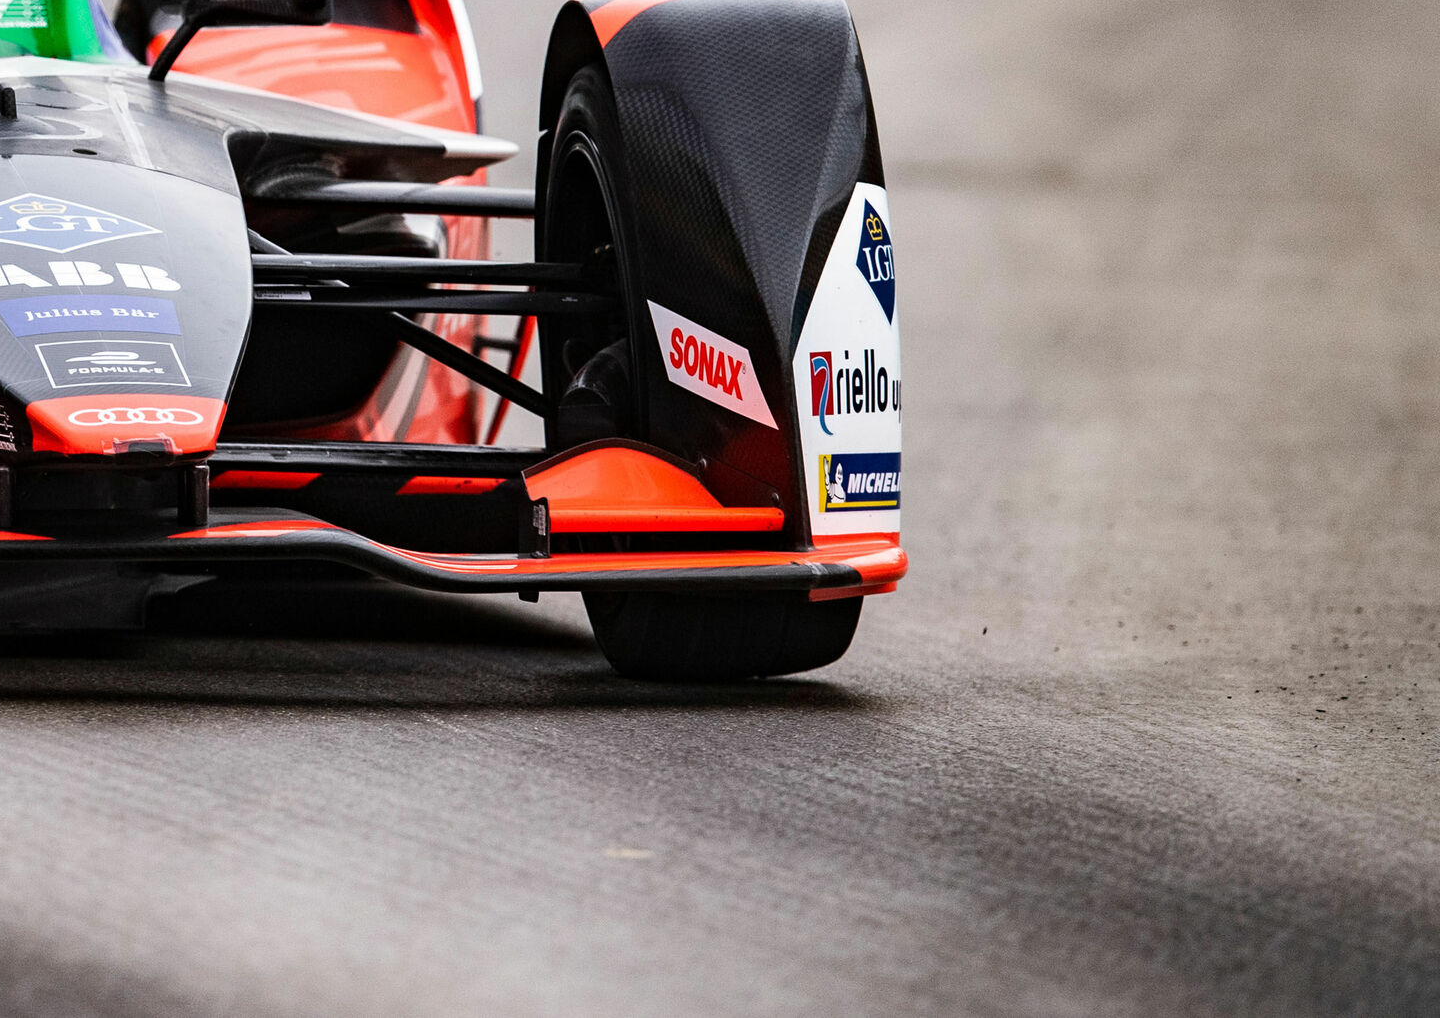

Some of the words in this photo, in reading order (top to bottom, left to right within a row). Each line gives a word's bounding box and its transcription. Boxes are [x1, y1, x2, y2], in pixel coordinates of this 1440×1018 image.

[26, 306, 102, 322] Julius
[111, 305, 160, 320] Bär
[669, 327, 743, 401] SONAX
[837, 349, 888, 414] riello
[847, 471, 902, 494] MICHELI
